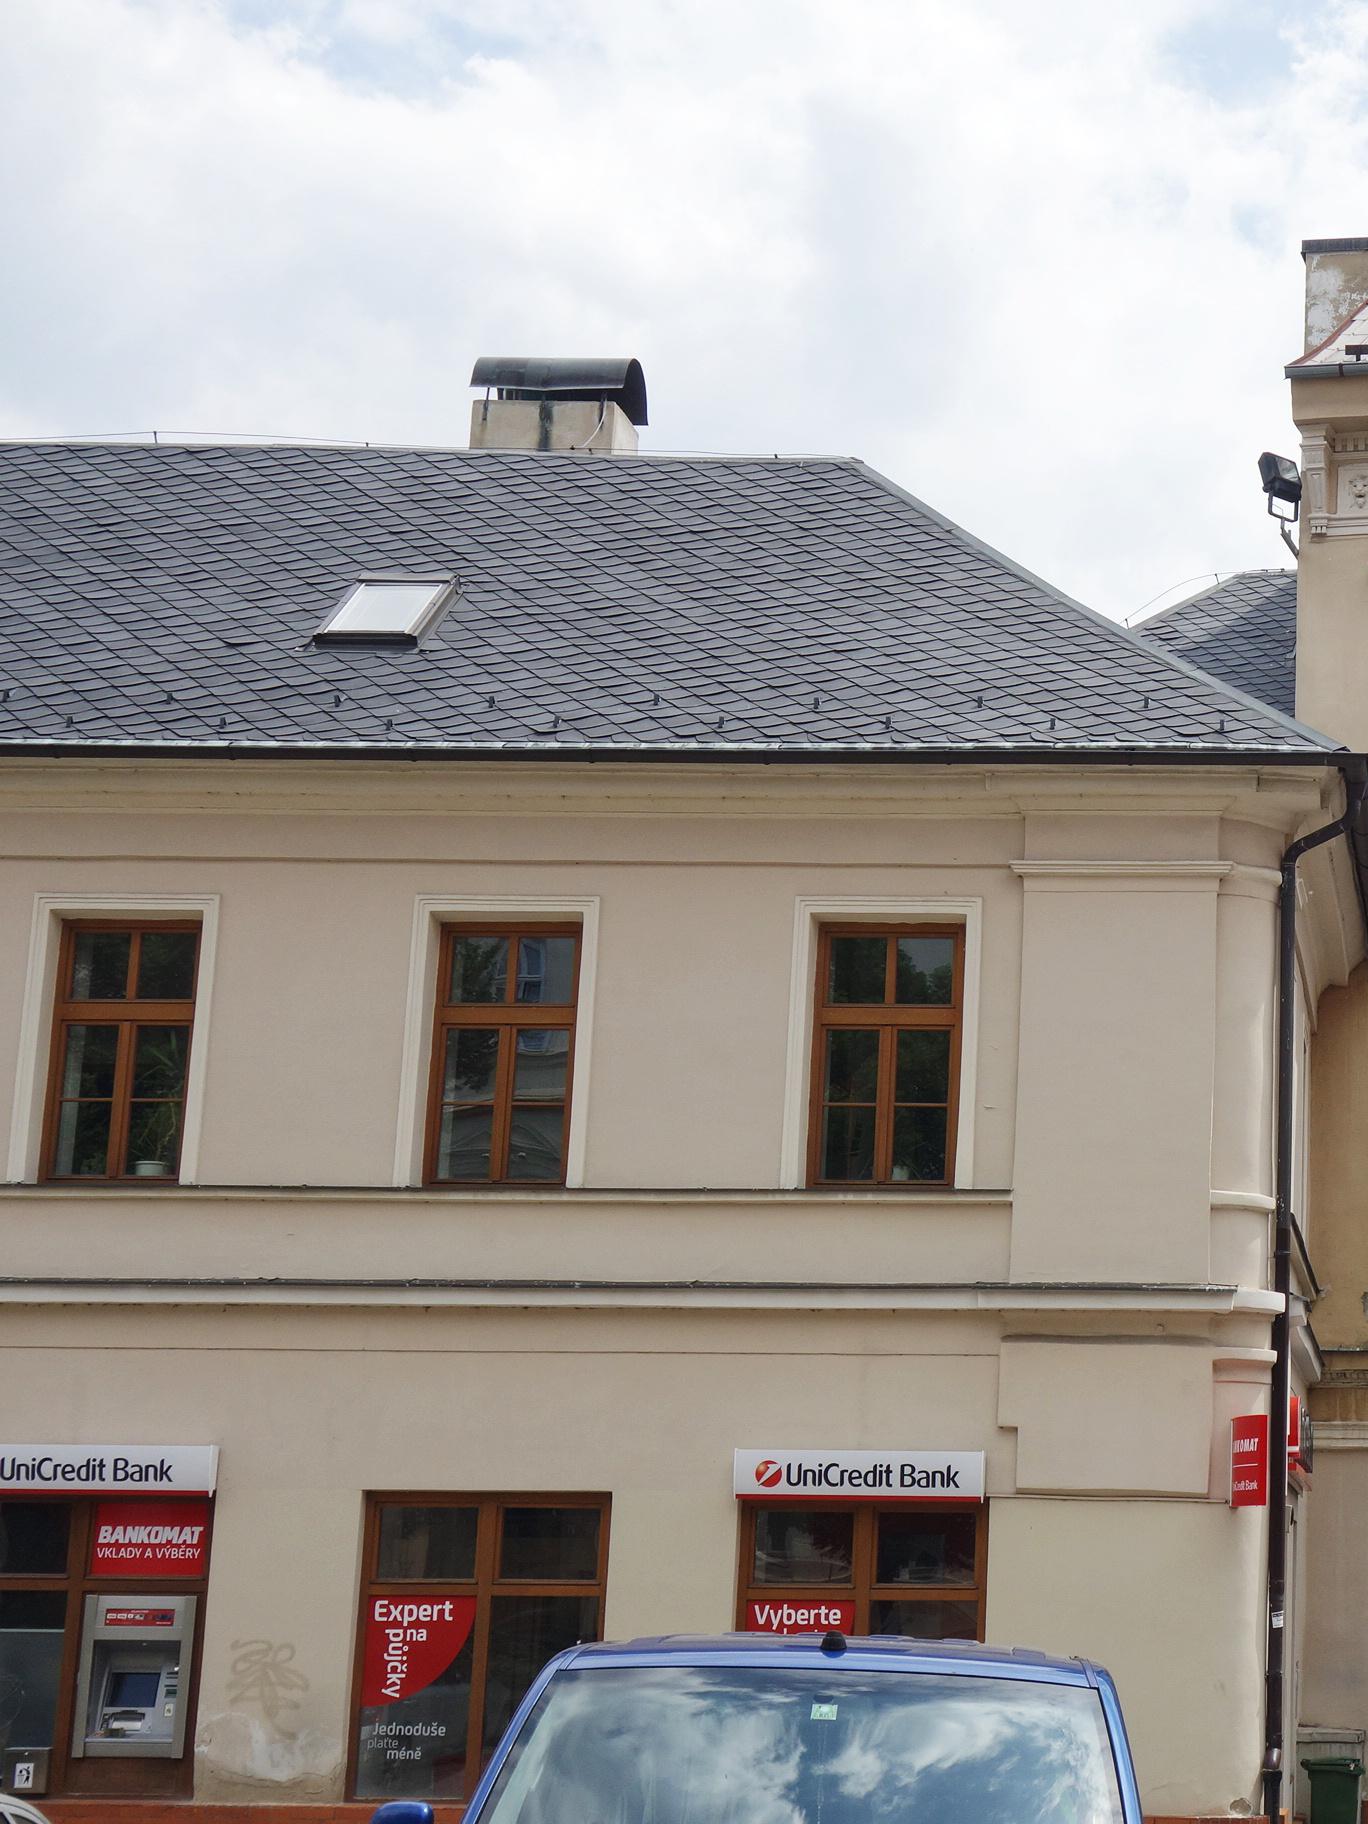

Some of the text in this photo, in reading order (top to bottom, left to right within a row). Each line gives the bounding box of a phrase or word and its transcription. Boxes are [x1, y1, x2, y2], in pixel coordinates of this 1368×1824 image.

[0, 1457, 173, 1482] UniCredit Bank
[786, 1462, 960, 1489] UniCredit Bank
[97, 1526, 204, 1545] BANKOMAT
[97, 1545, 201, 1559] VKLADY A VÝBĚRY
[374, 1600, 454, 1627] Expert
[754, 1603, 842, 1630] Vyberte
[406, 1629, 427, 1642] na
[381, 1628, 408, 1698] půjčky
[372, 1722, 446, 1737] Jednoduše
[367, 1737, 399, 1749] plaťte
[387, 1747, 422, 1760] méně
